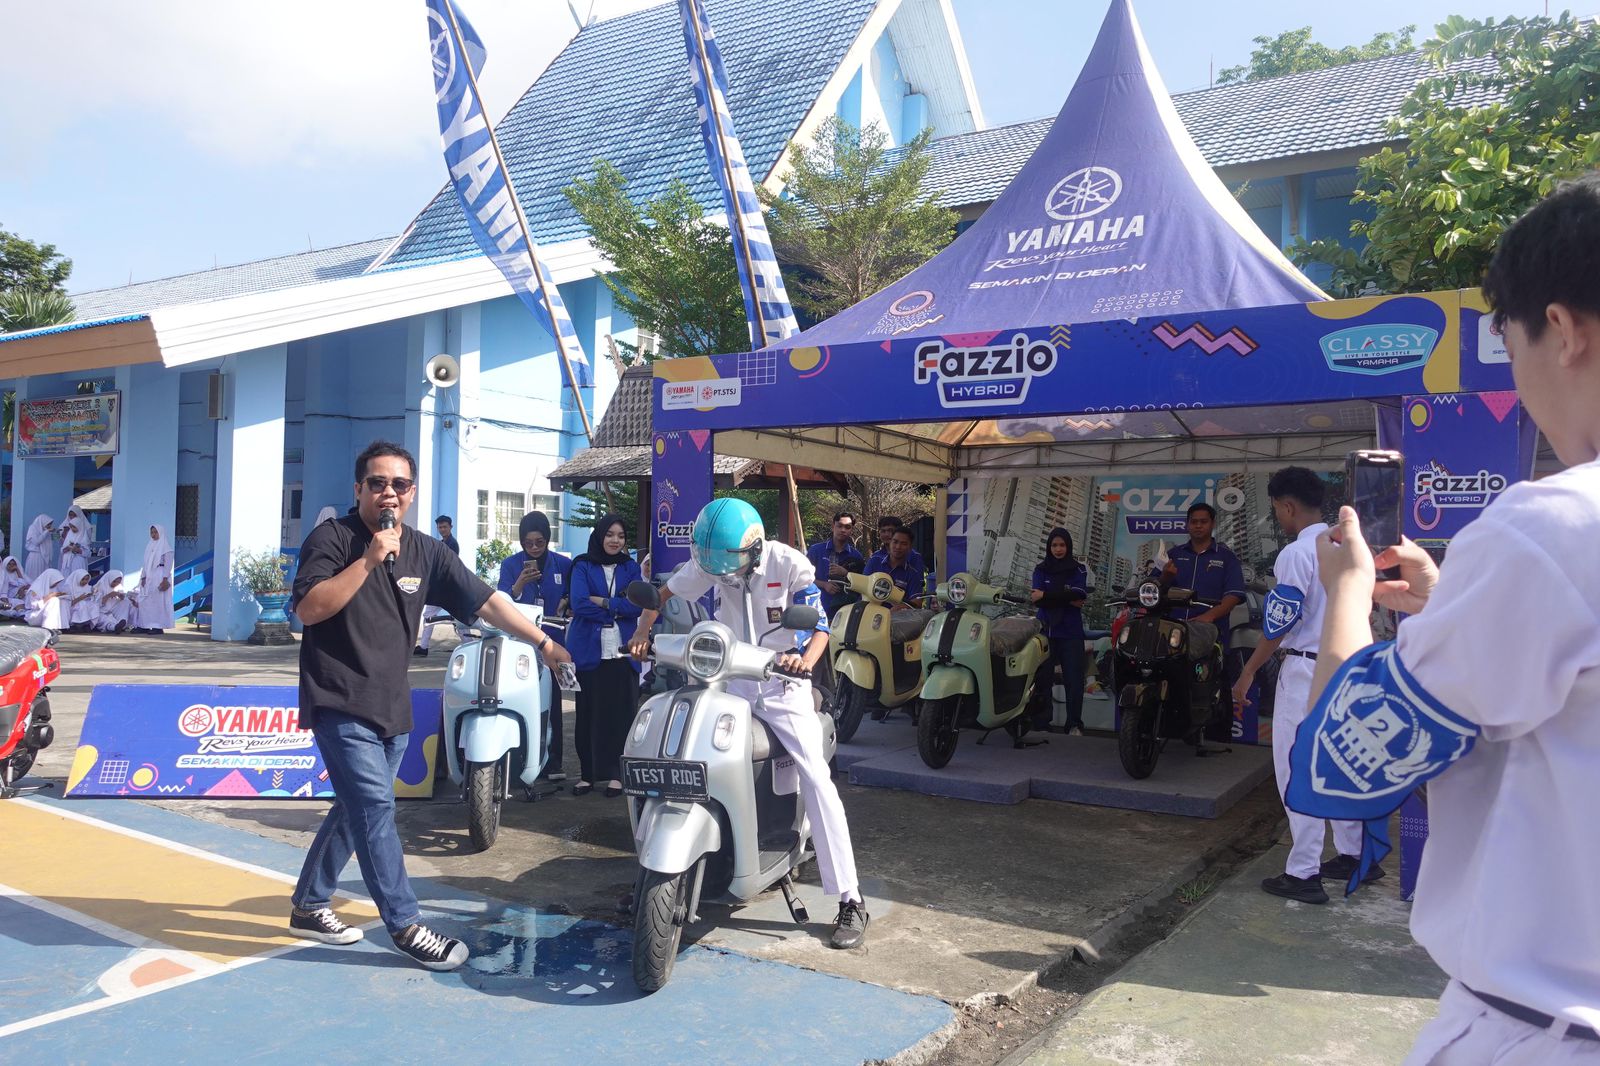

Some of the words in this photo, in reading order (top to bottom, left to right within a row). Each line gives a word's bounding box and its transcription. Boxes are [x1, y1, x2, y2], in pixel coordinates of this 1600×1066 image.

[1007, 216, 1144, 254] YAMAHA
[983, 255, 1039, 272] Revs
[1039, 249, 1080, 265] your
[1080, 241, 1129, 255] Heart
[967, 274, 1052, 289] SEMAKIN
[1054, 272, 1074, 280] DI
[1076, 263, 1147, 279] DEPAN
[1328, 332, 1428, 352] CLASSY
[918, 337, 1053, 380] Fazzio
[1356, 358, 1399, 366] YAMAHA
[673, 386, 694, 394] YAMAHA
[713, 388, 737, 396] PT.STSJ
[951, 384, 1016, 397] HYBRID
[1417, 472, 1504, 492] Fazzio
[1100, 479, 1245, 512] Fazzio
[659, 522, 694, 536] Fazzi
[1135, 520, 1186, 530] HYBR
[216, 709, 309, 733] YAMAH
[1366, 718, 1389, 738] 2
[201, 738, 244, 751] Revs
[245, 739, 273, 751] your
[274, 737, 310, 745] Heart
[181, 757, 245, 765] SEMAKIN
[248, 758, 262, 766] DI
[263, 758, 312, 766] DEPAN
[776, 760, 795, 770] Fazzi
[633, 768, 665, 784] TEST
[670, 769, 702, 787] RIDE
